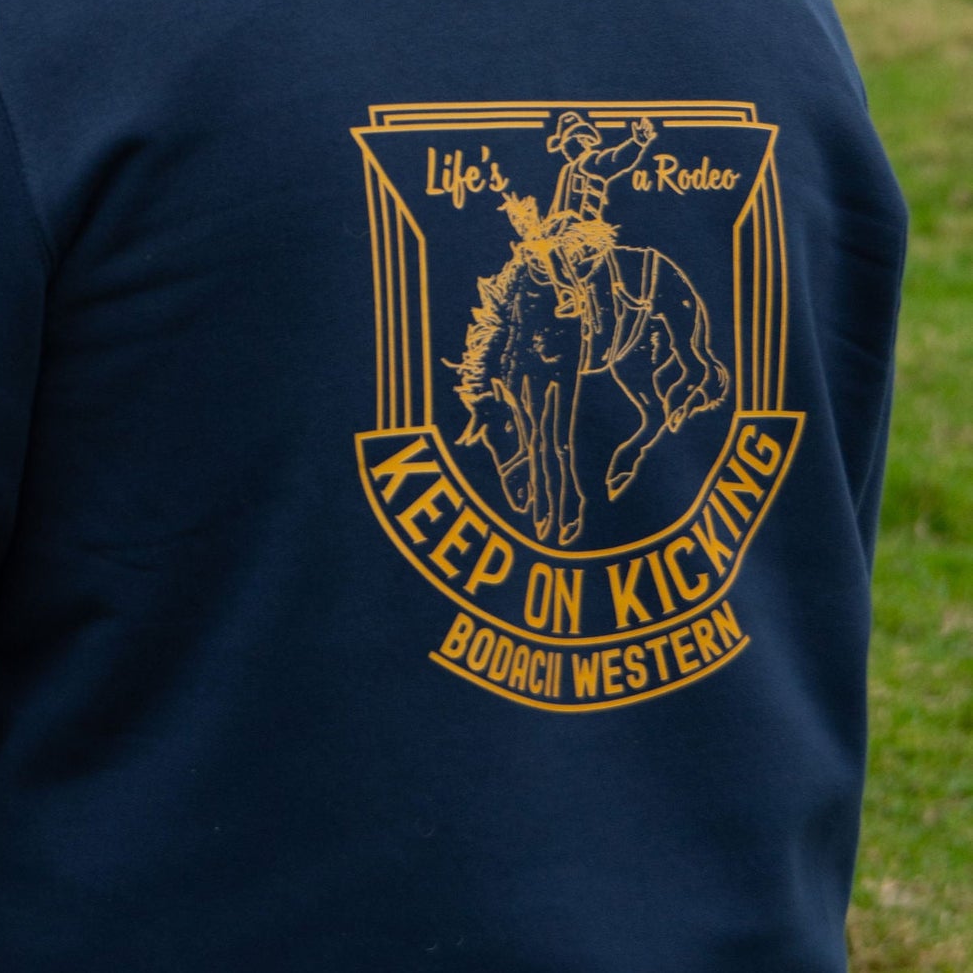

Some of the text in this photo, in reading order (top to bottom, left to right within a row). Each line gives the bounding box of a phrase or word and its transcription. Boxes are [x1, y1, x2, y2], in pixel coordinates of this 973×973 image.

[426, 145, 740, 209] Life's a Rodeo
[370, 424, 784, 634] KEEP ON KICKING
[440, 600, 743, 699] BODACII WESTERN
